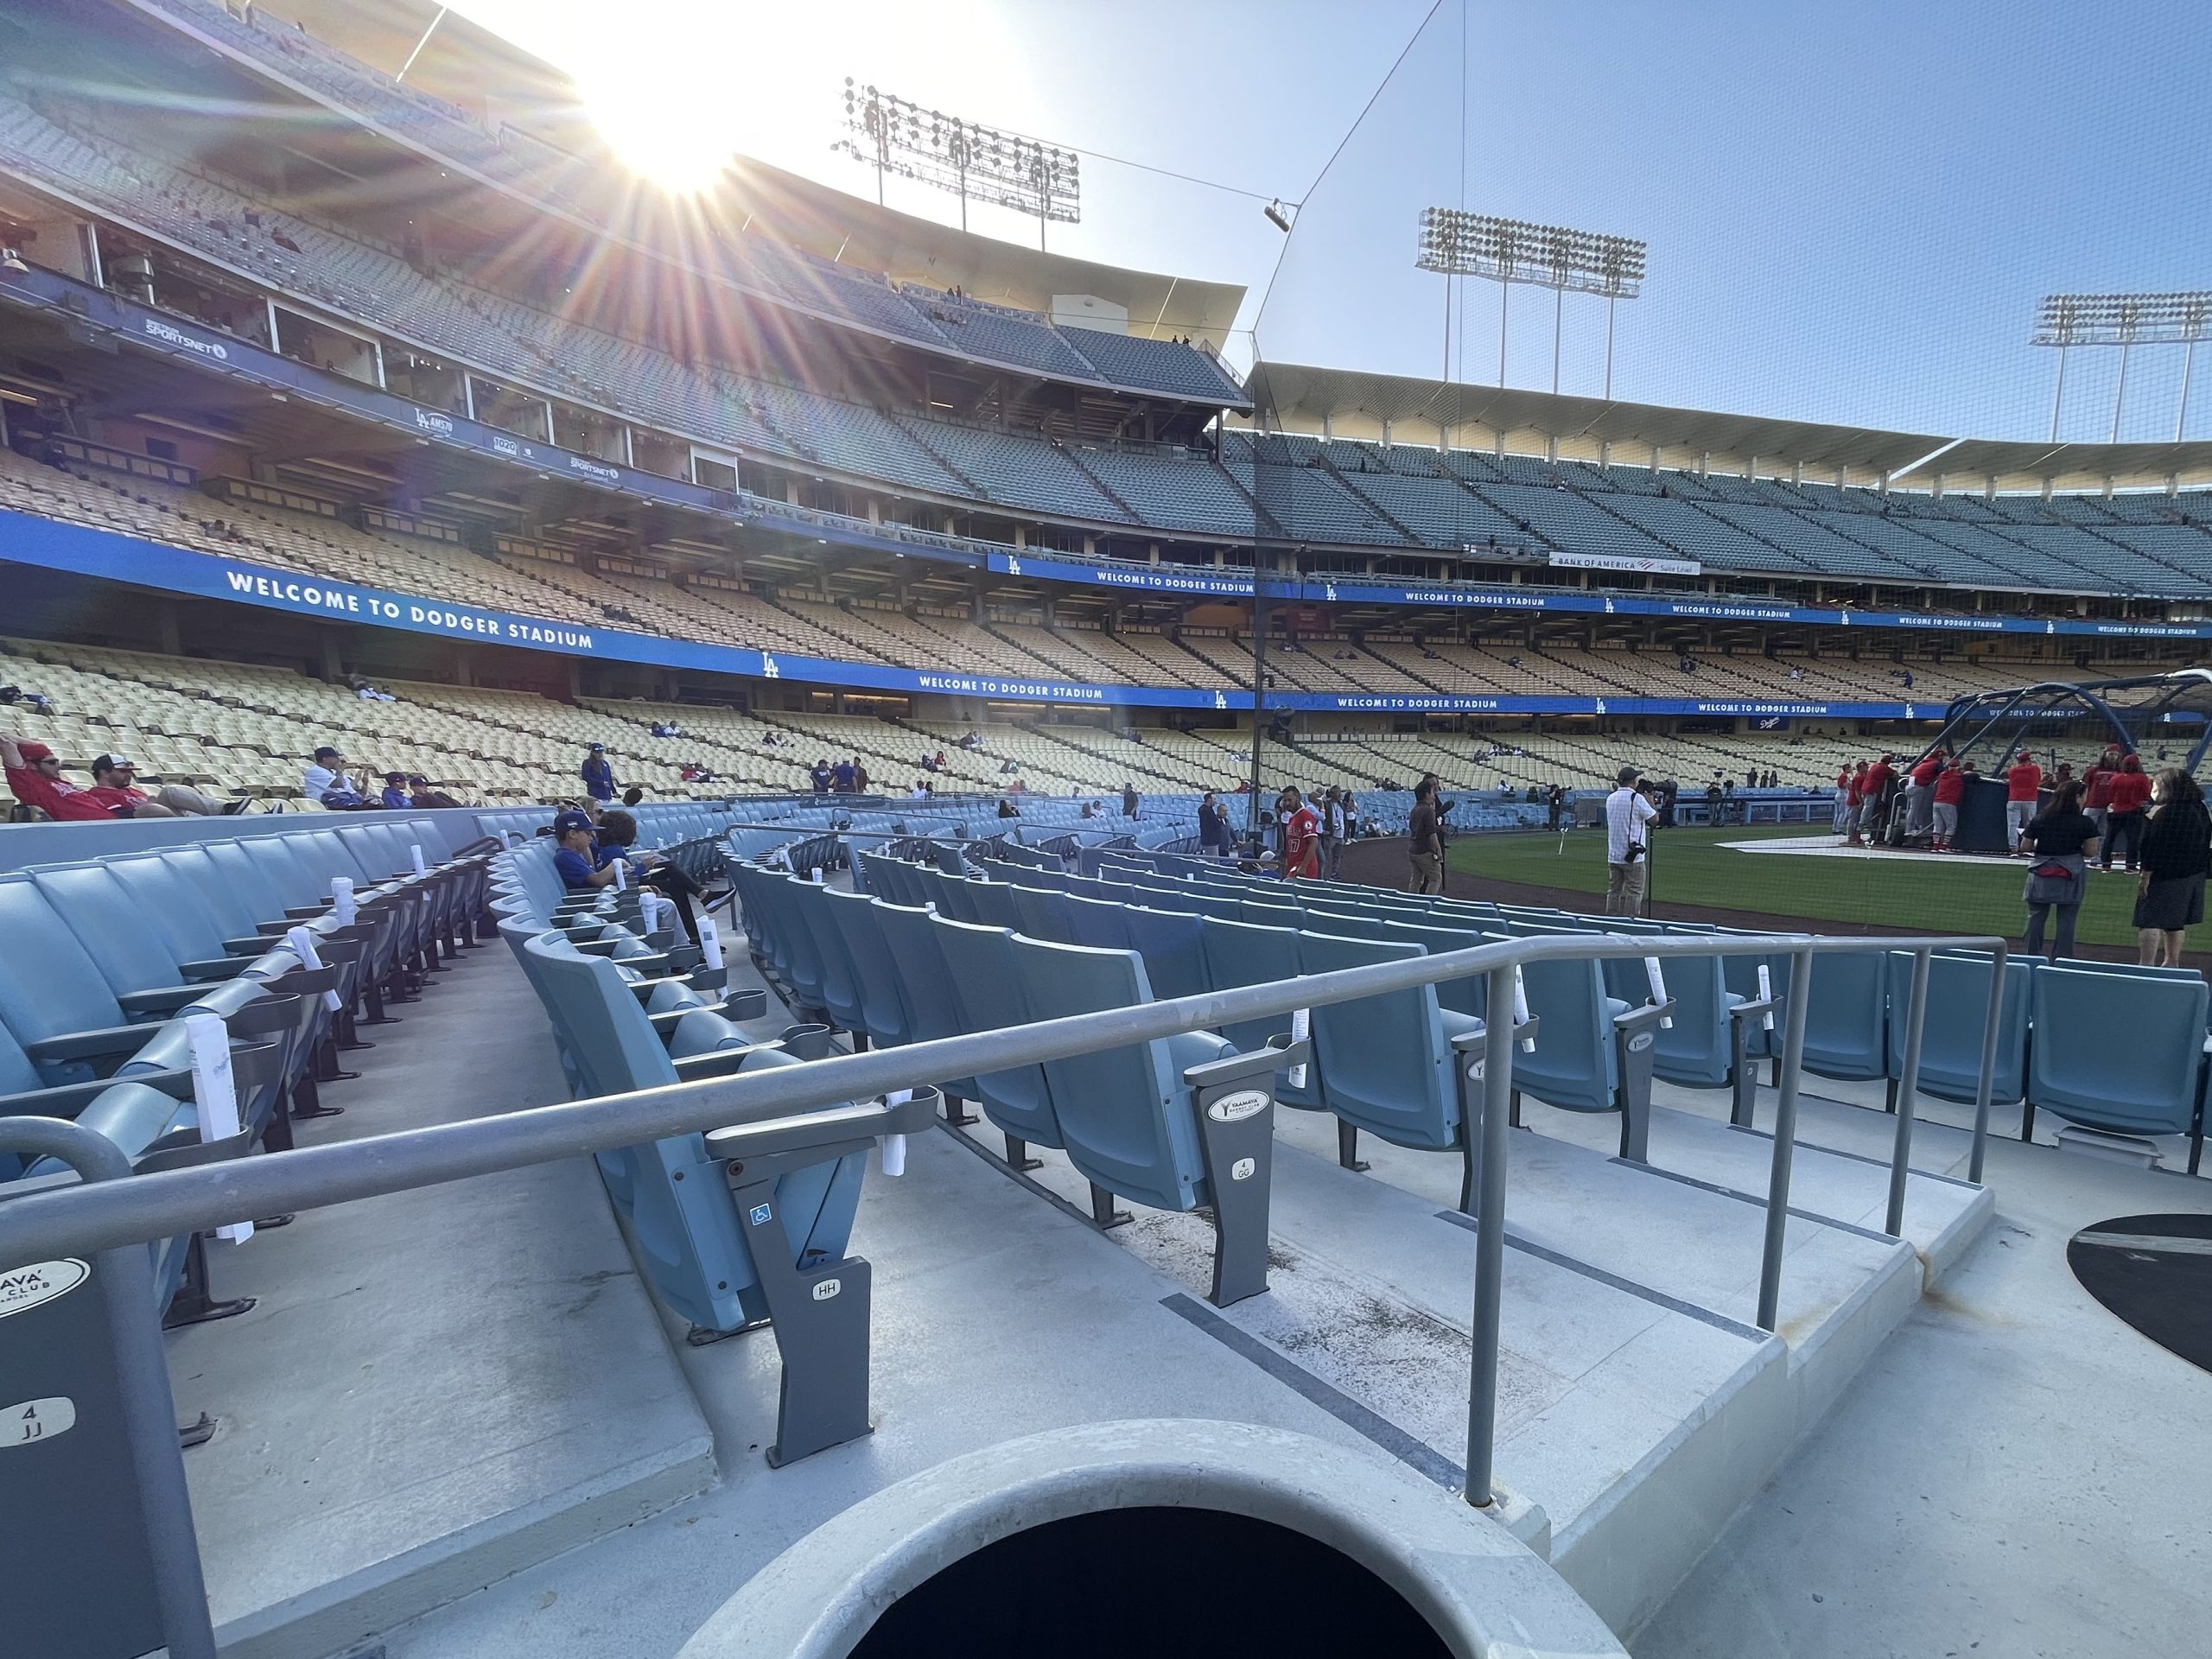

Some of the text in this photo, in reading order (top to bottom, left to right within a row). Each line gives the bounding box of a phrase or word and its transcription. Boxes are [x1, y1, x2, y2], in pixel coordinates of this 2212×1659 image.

[145, 323, 213, 354] SPORTSNET
[1008, 556, 1020, 575] LA
[1558, 557, 1636, 570] BANK OF AMERICA
[1660, 564, 1693, 575] Suite Level
[1096, 571, 1254, 593] WELCOME TO DODGER STADIUM
[1326, 584, 1337, 601] LA
[1405, 592, 1449, 602] WELCOME
[1466, 594, 1503, 604] DODGER
[1506, 597, 1545, 606] STADIUM
[227, 571, 593, 649] WELCOME TO DODGER STADIUM
[1672, 605, 1710, 614] WELCOME
[1724, 607, 1756, 616] DODGER
[1758, 609, 1790, 619] STADIUM
[1899, 617, 1932, 626] WELCOME
[1943, 619, 1972, 627] DODGER
[762, 652, 779, 678] LA
[918, 676, 1103, 699] WELCOME TO DODGER STADIUM
[1215, 690, 1226, 709] LA
[1338, 698, 1497, 709] WELCOME TO DODGER STADIUM
[1597, 697, 1605, 714] LA
[1698, 703, 1738, 712] WELCOME
[1755, 704, 1789, 713] DODGER
[1791, 705, 1827, 714] STADIUM
[1238, 1168, 1249, 1178] GG
[8, 1281, 50, 1296] CLUB
[819, 1283, 835, 1296] HH
[22, 1406, 36, 1420] 4
[22, 1422, 41, 1440] JJ
